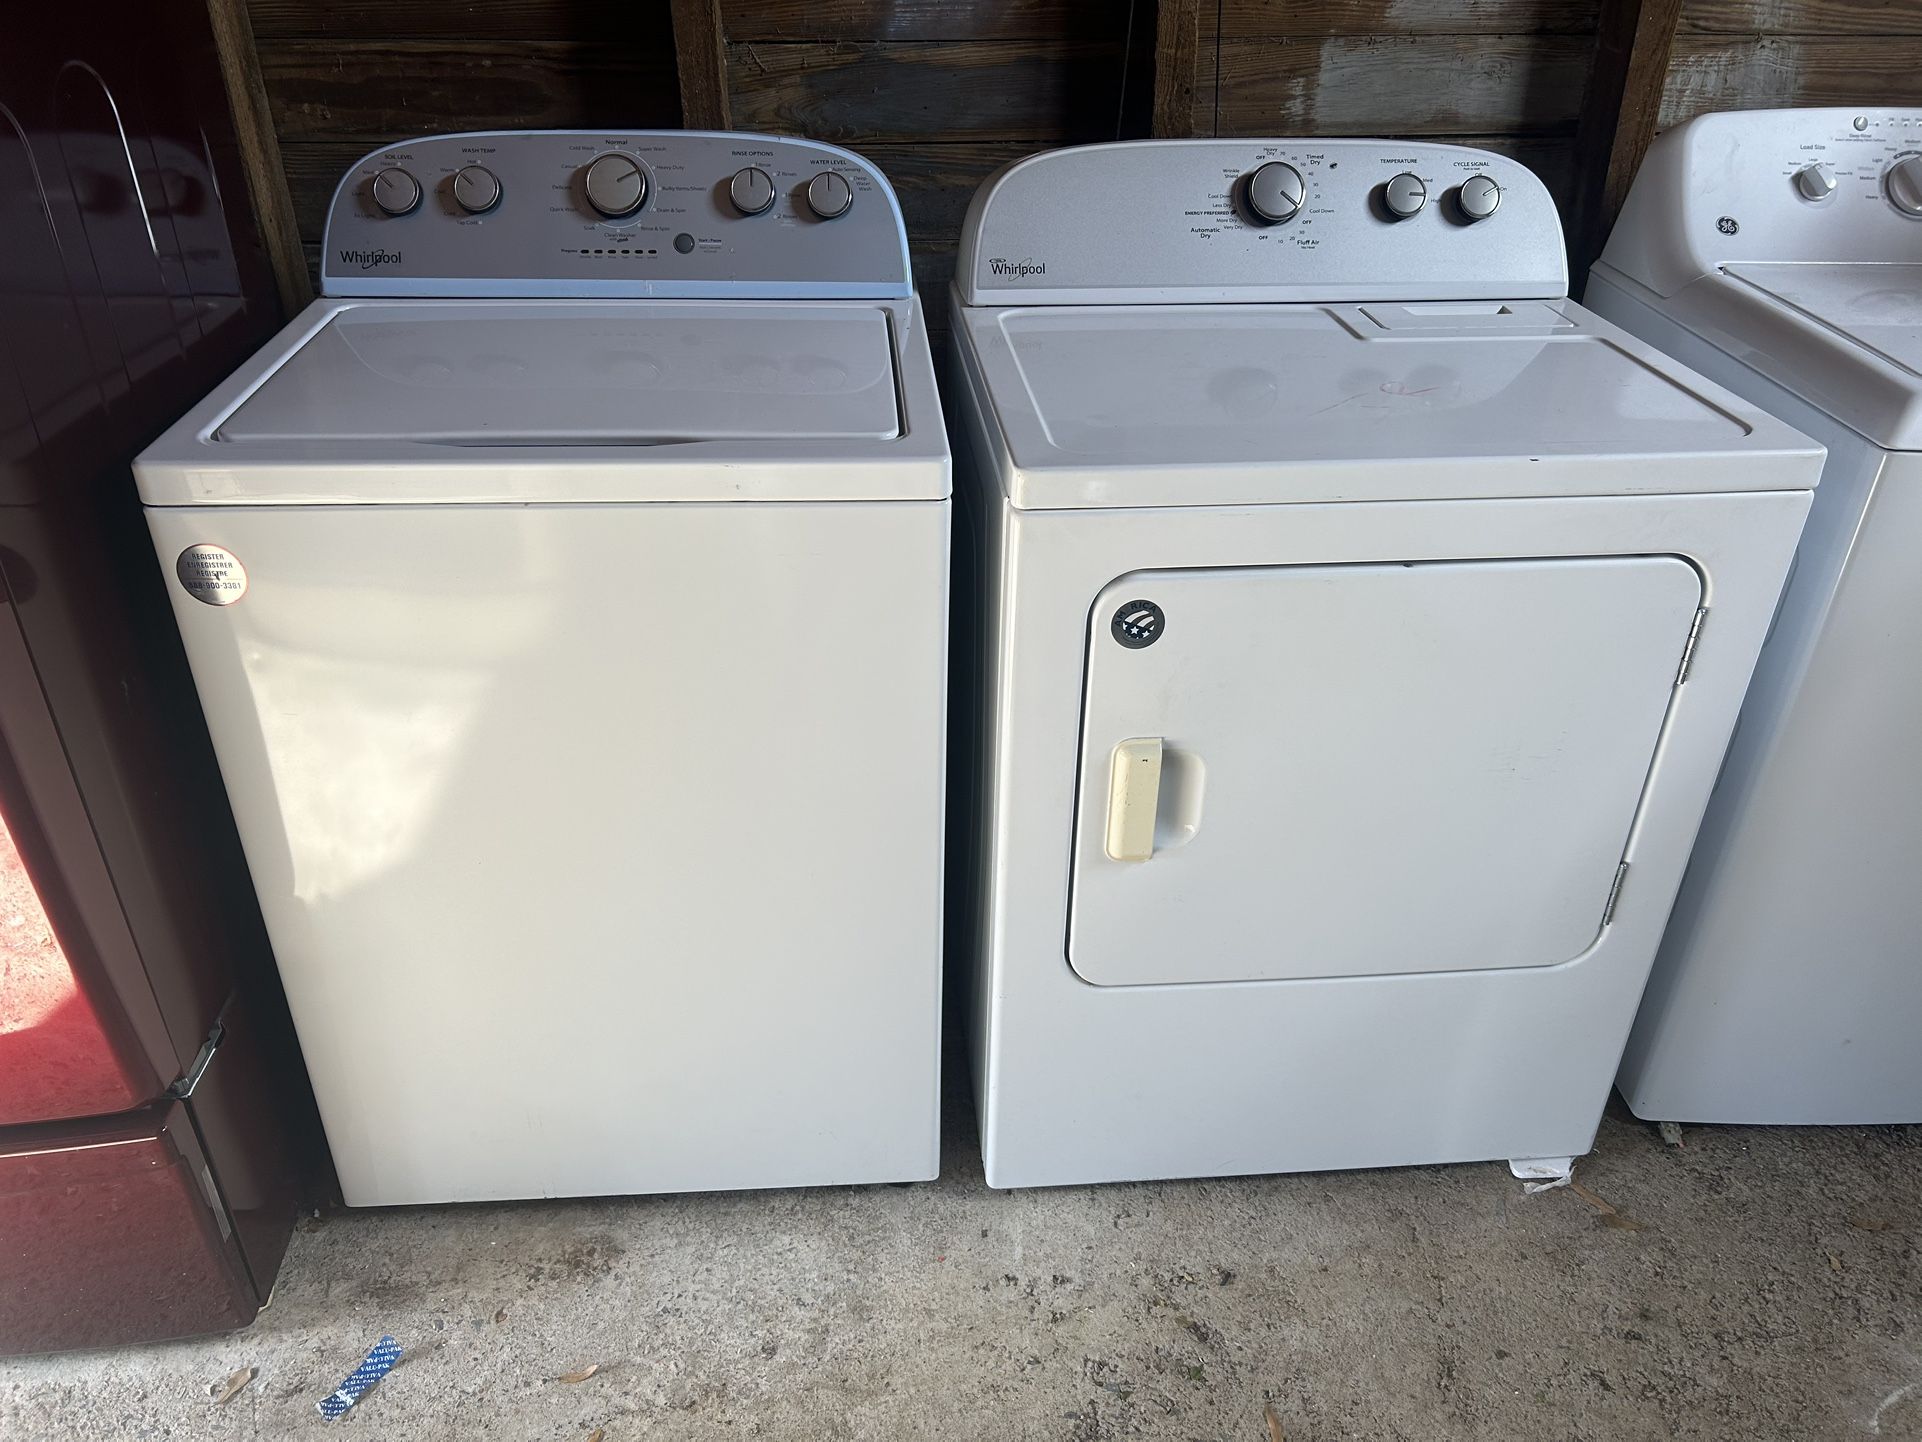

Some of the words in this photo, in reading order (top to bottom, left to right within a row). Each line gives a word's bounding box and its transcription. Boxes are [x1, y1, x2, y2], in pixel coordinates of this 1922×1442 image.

[340, 250, 402, 267] Whirlpool
[991, 262, 1046, 278] Whirlpool
[373, 1346, 402, 1354] VALU-PAK
[360, 1363, 390, 1372] VALU-PAK
